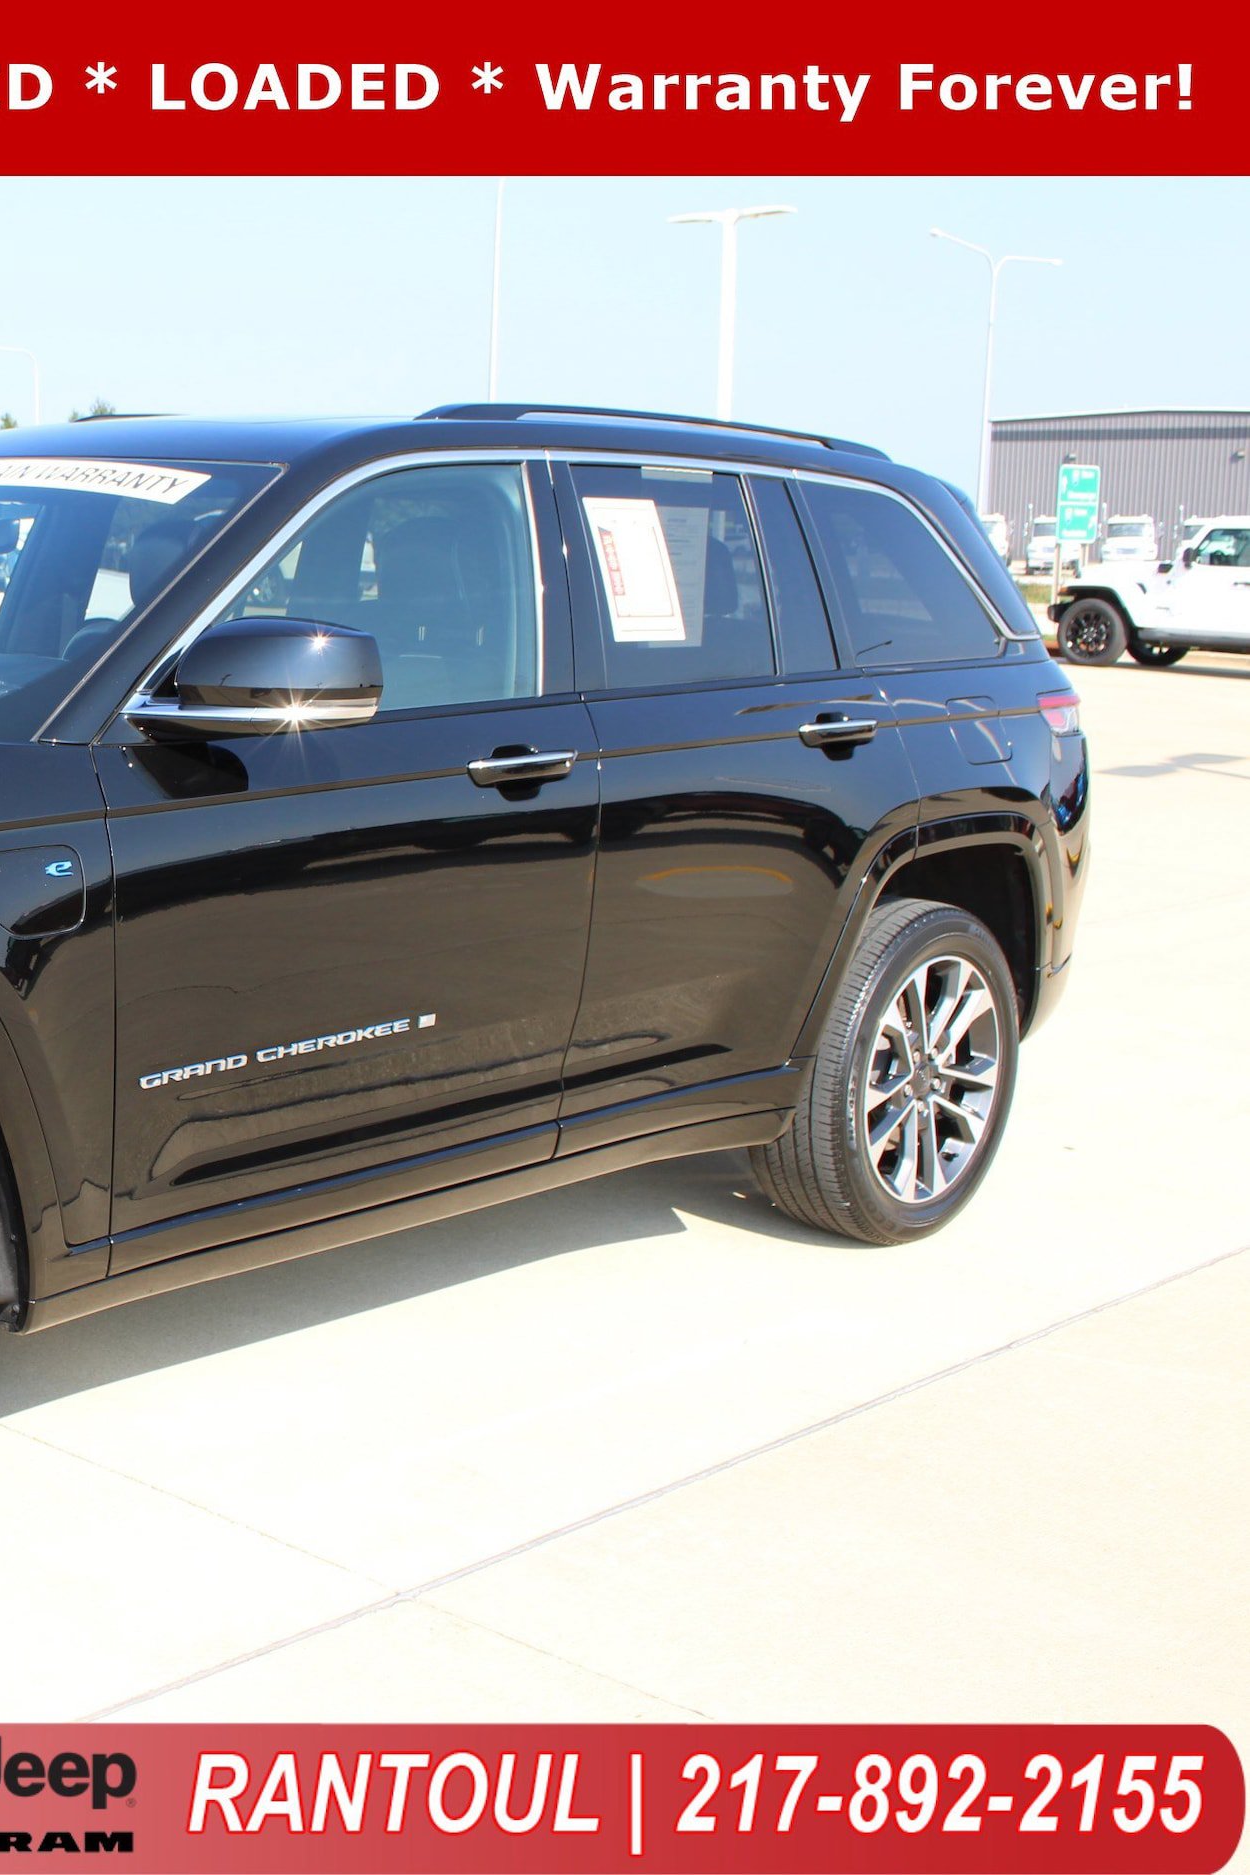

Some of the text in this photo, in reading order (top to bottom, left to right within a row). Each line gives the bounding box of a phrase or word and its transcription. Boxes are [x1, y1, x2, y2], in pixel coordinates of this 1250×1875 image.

[34, 464, 188, 494] WARRANTY
[139, 1018, 411, 1090] GRAND CHEROKEE
